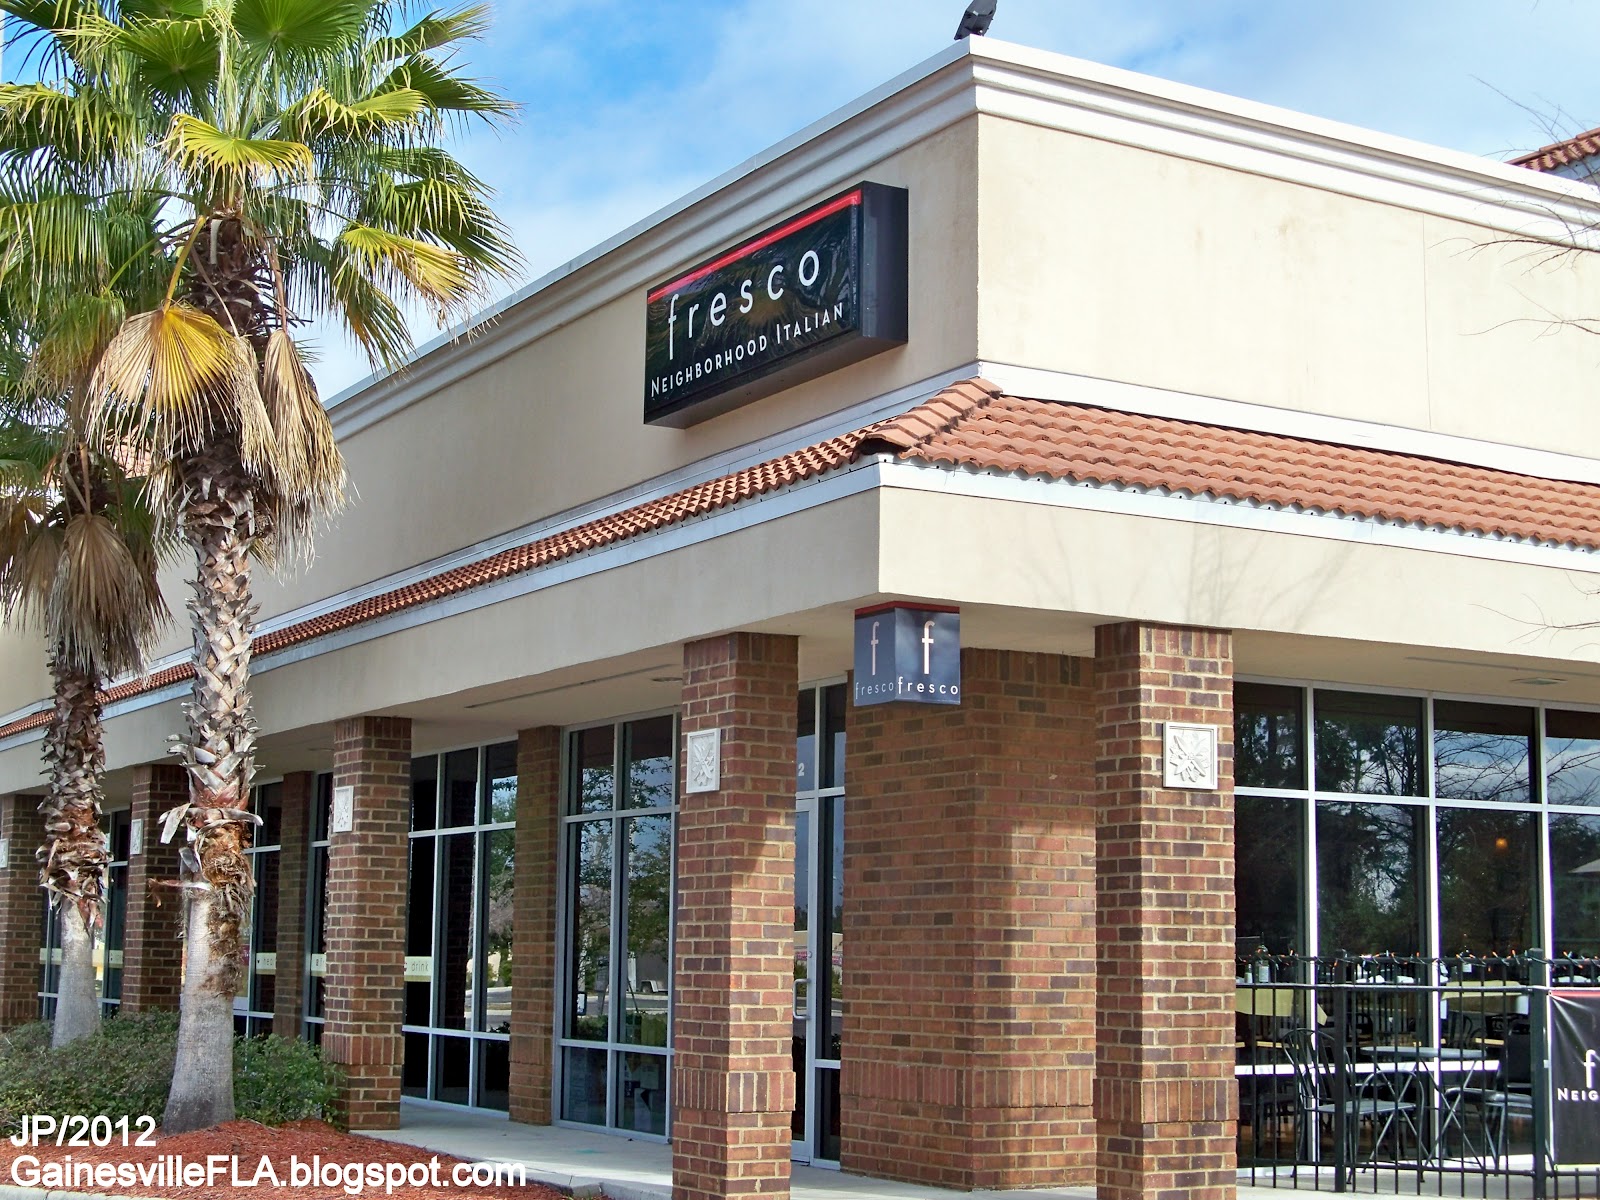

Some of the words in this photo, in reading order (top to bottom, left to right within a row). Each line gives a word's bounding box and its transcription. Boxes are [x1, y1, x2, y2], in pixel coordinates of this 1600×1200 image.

[668, 250, 820, 360] fresco
[651, 334, 767, 398] NEIGHBORHOOD
[776, 302, 844, 345] ITALIAN
[870, 621, 880, 676] f
[921, 620, 935, 675] f
[855, 681, 894, 700] fresco
[897, 676, 959, 695] fresco
[411, 961, 429, 972] drink
